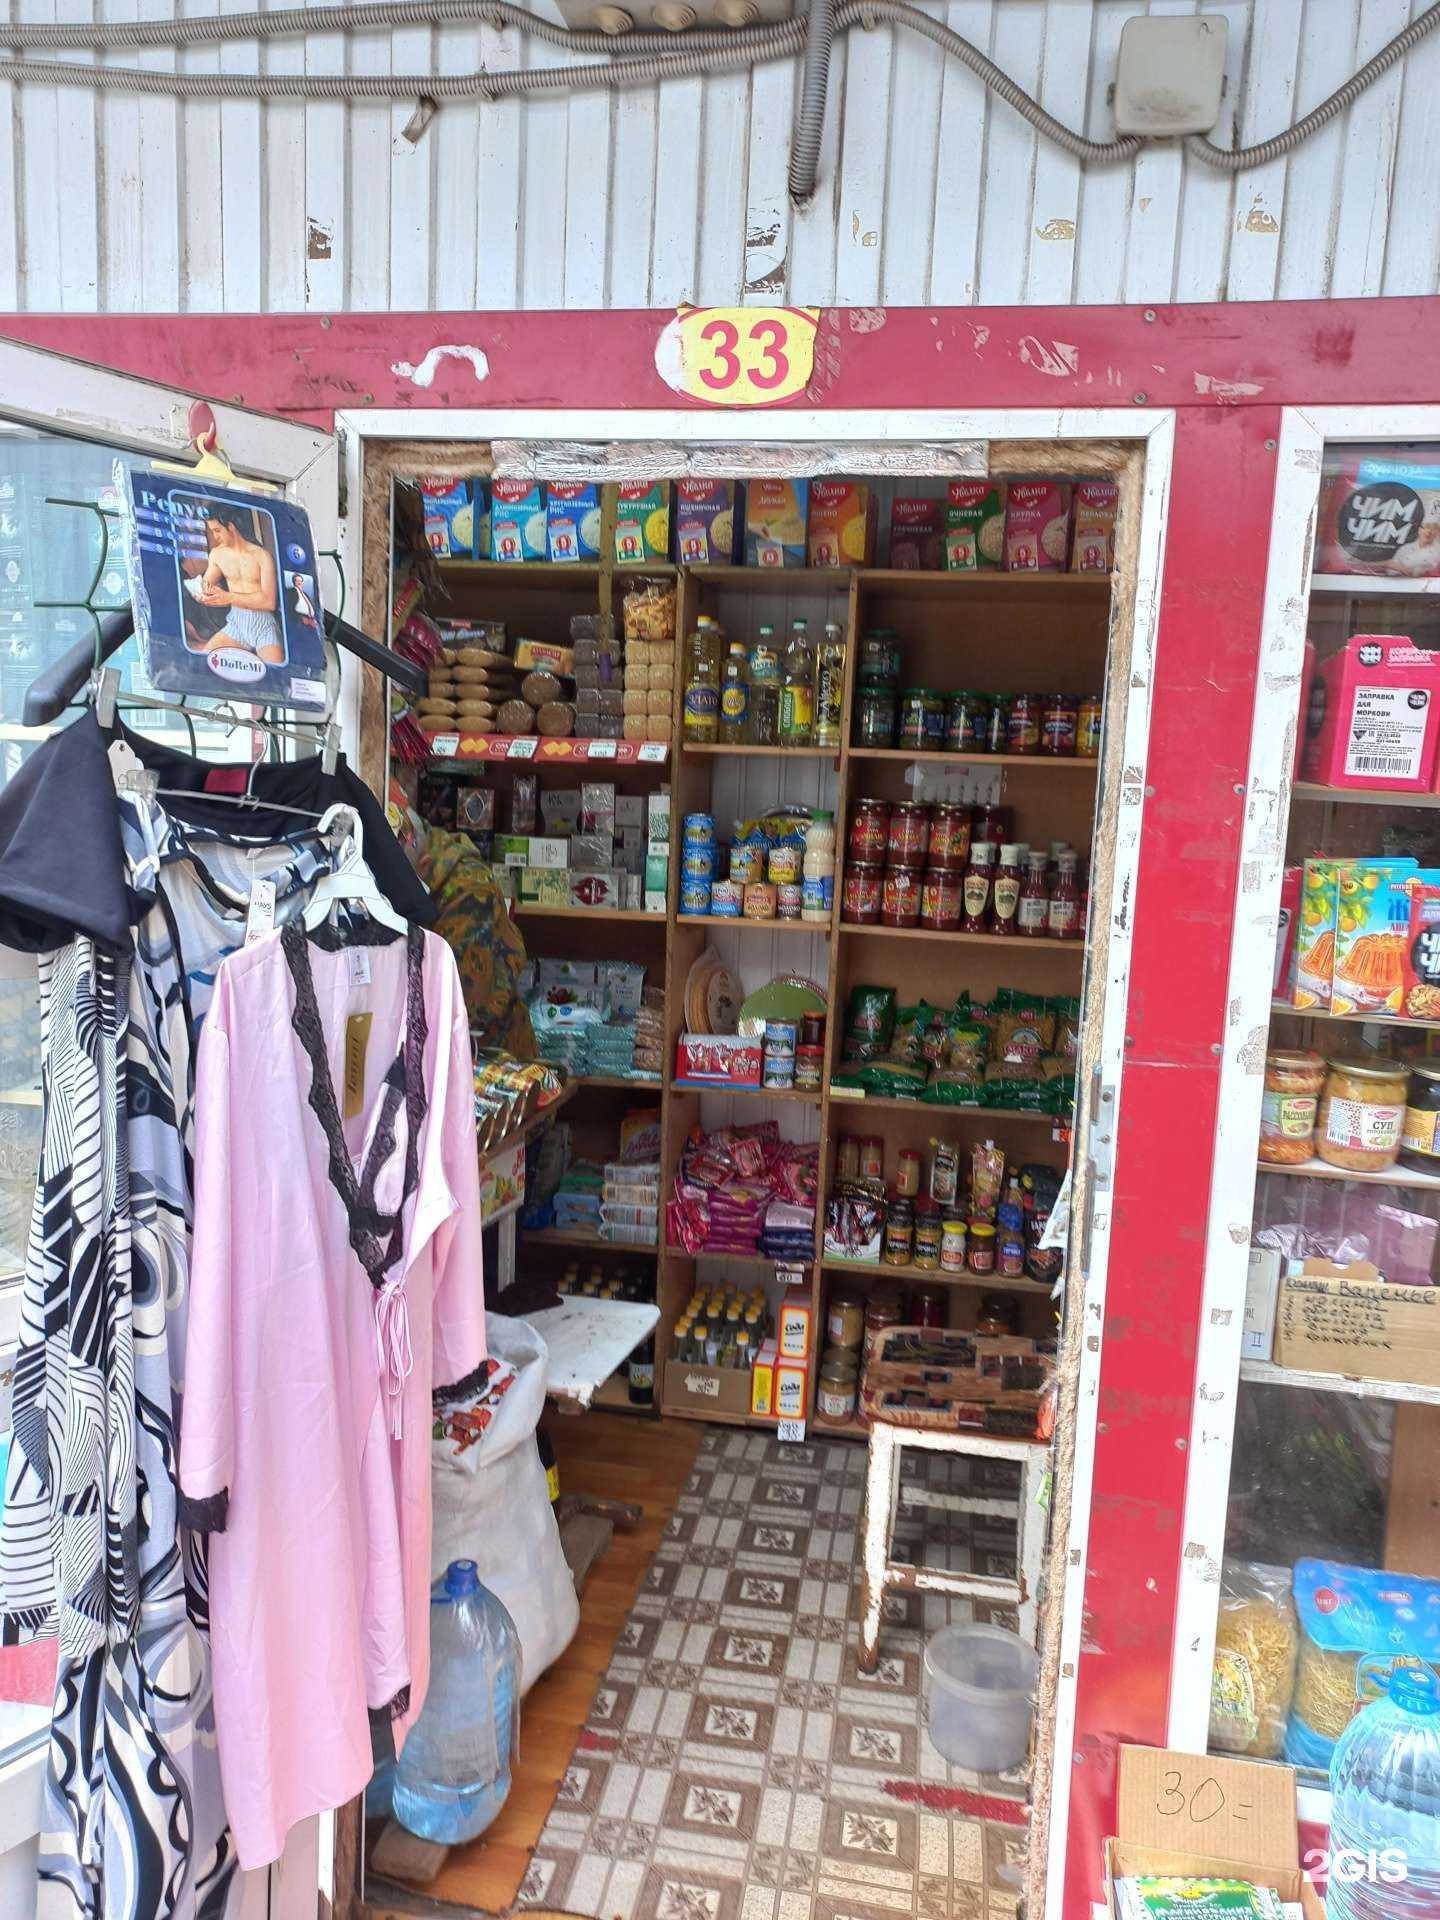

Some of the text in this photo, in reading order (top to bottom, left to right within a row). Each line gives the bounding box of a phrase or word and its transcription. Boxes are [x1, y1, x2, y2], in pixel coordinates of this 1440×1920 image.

[699, 319, 789, 390] 33
[220, 658, 262, 674] DoReMi
[1358, 692, 1395, 701] ЗАПРАВКА
[1356, 709, 1391, 717] МОРКОВИ
[1372, 1121, 1394, 1130] СУП
